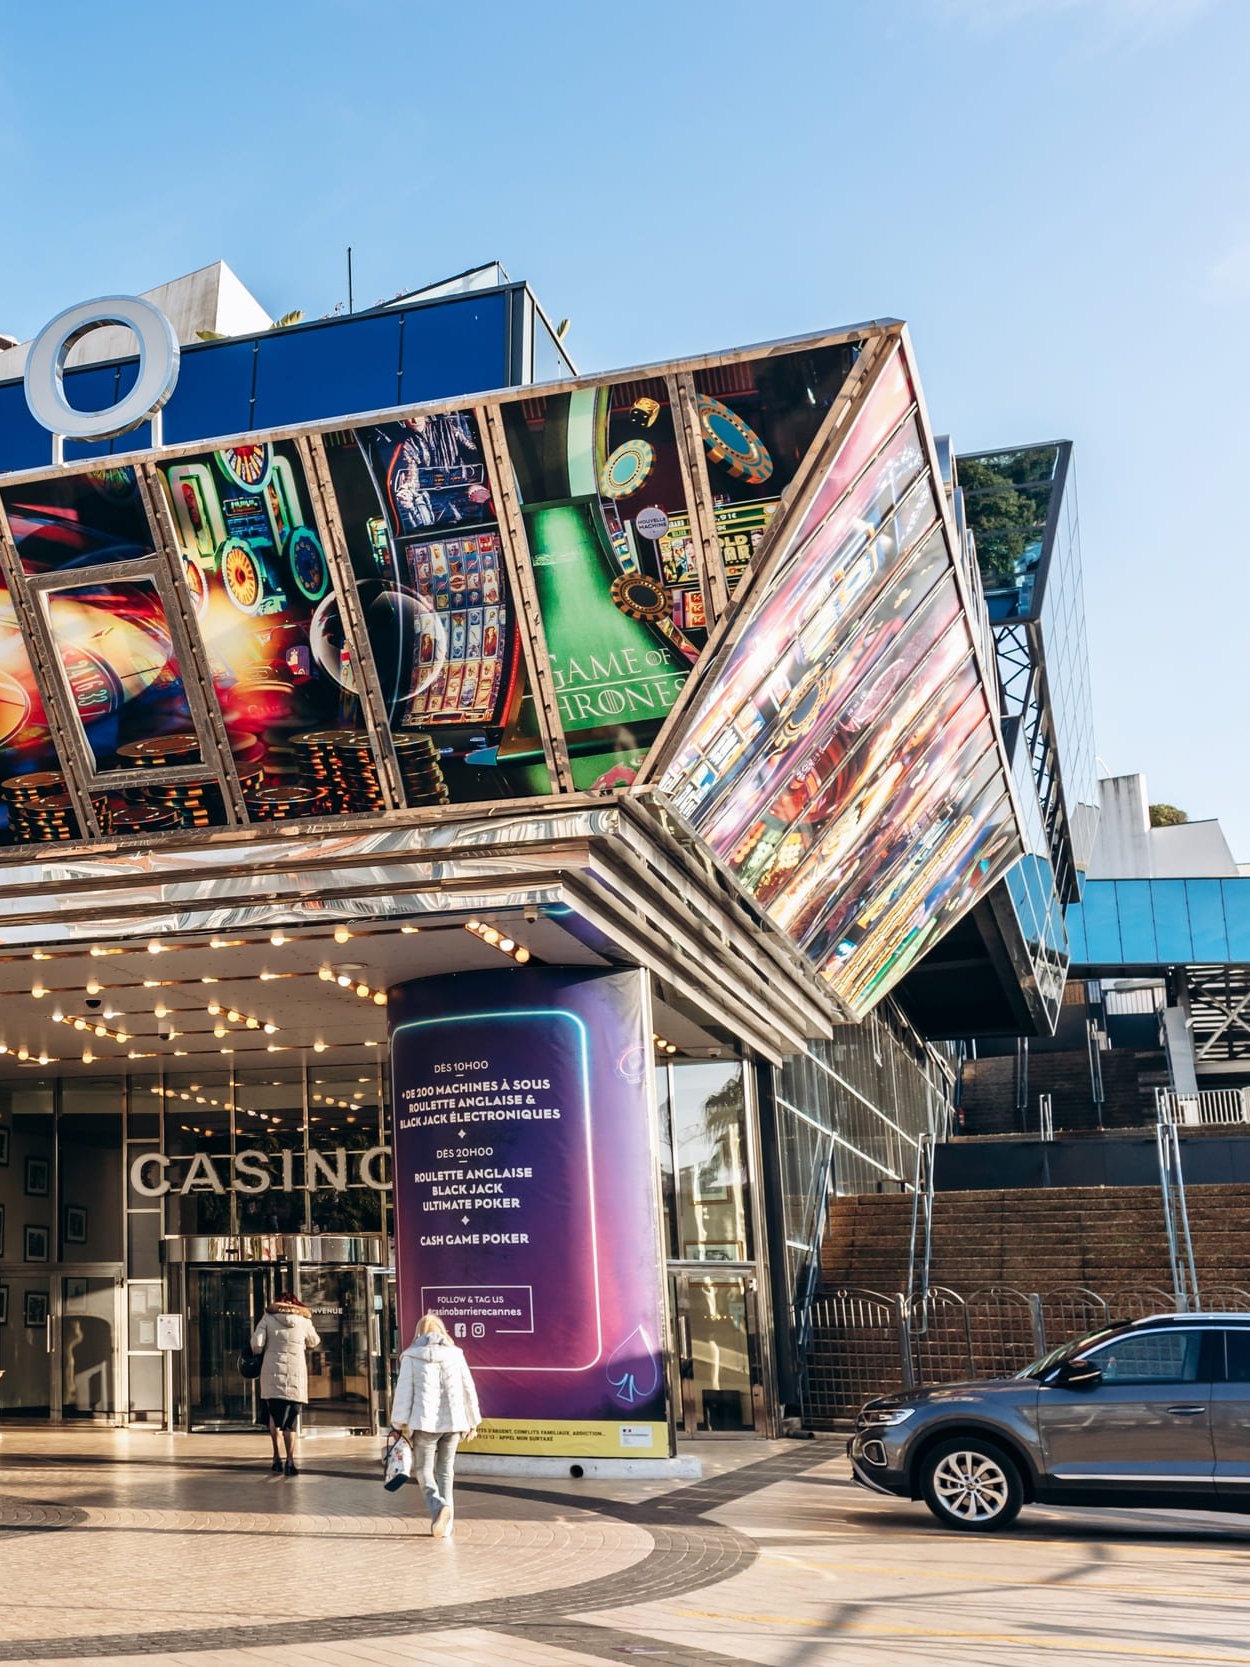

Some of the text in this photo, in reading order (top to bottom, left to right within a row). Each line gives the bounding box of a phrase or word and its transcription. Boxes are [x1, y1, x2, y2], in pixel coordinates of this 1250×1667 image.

[718, 534, 748, 548] OLD
[645, 648, 671, 667] OF
[559, 678, 687, 721] HRONE
[406, 1088, 416, 1099] DE
[416, 1086, 434, 1098] 200
[436, 1081, 498, 1095] MACHINES
[501, 1078, 510, 1090] À
[513, 1079, 551, 1090] SOUS
[409, 1094, 536, 1113] ROULETTE ANGLAISE &
[400, 1108, 561, 1130] BLACK JACK ÉLECTRONIQUES
[130, 1146, 392, 1197] CASINO
[414, 1167, 533, 1183] ROULETTE ANGLAISE
[432, 1183, 504, 1197] BLACK JACK
[423, 1198, 521, 1212] ULTIMATE POKER
[420, 1233, 530, 1246] CASH GAME POKER
[437, 1296, 466, 1304] FOLLOW
[311, 1307, 343, 1315] NVENUE
